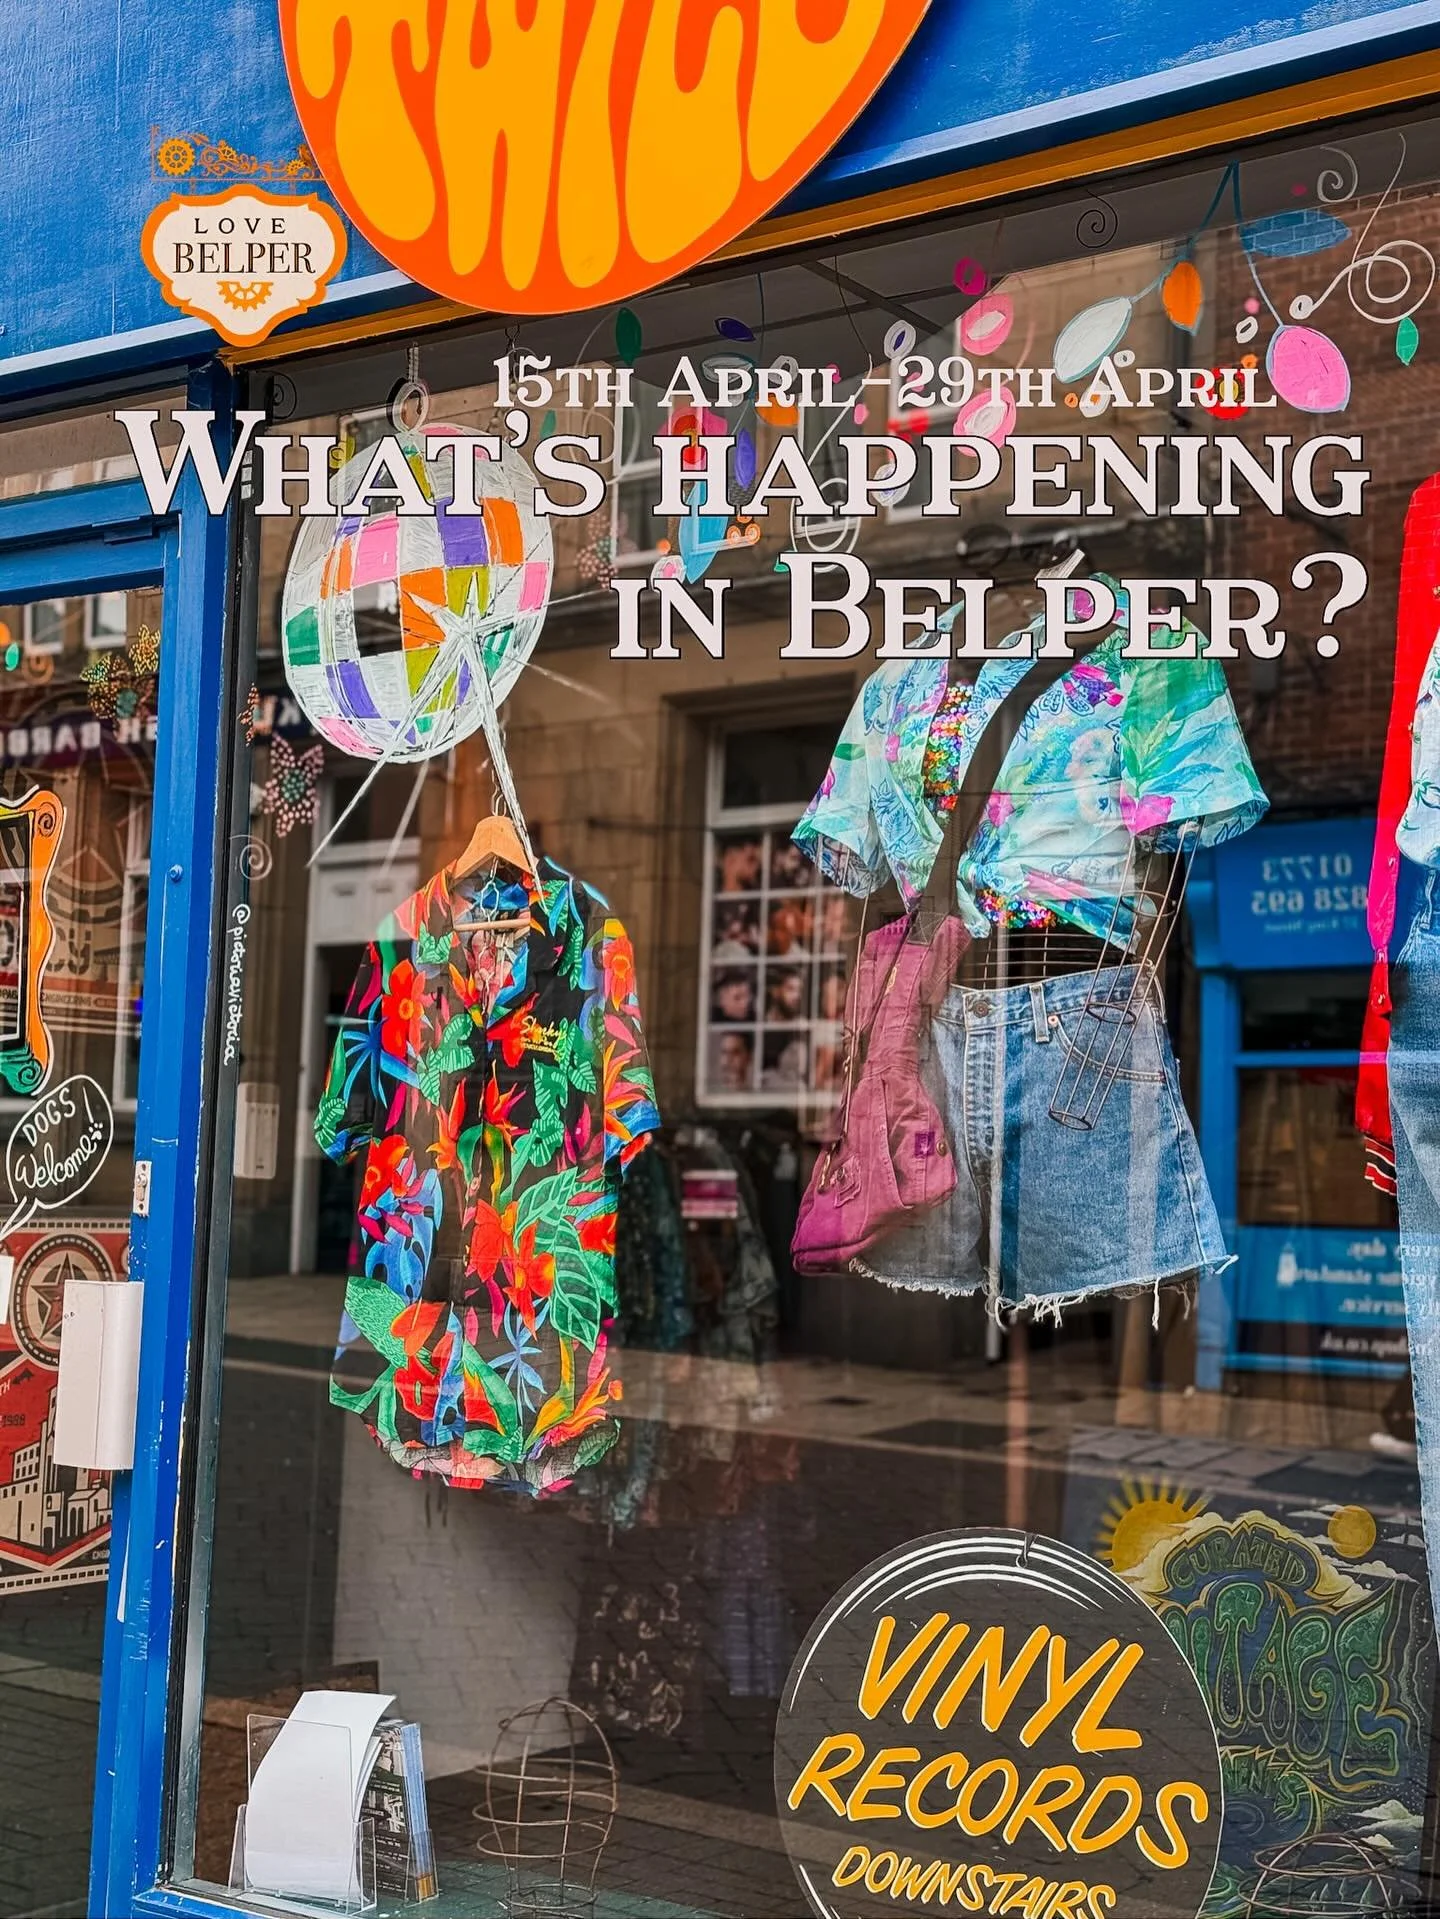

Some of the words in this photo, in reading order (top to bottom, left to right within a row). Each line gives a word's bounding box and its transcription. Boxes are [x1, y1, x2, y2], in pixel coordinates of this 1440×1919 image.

[22, 1087, 76, 1147] DOGS
[1170, 1536, 1306, 1588] CURATED
[858, 1612, 1144, 1754] VINYL
[787, 1733, 1209, 1869] RECORDS
[831, 1845, 1117, 1919] DOWNSTAIRS
